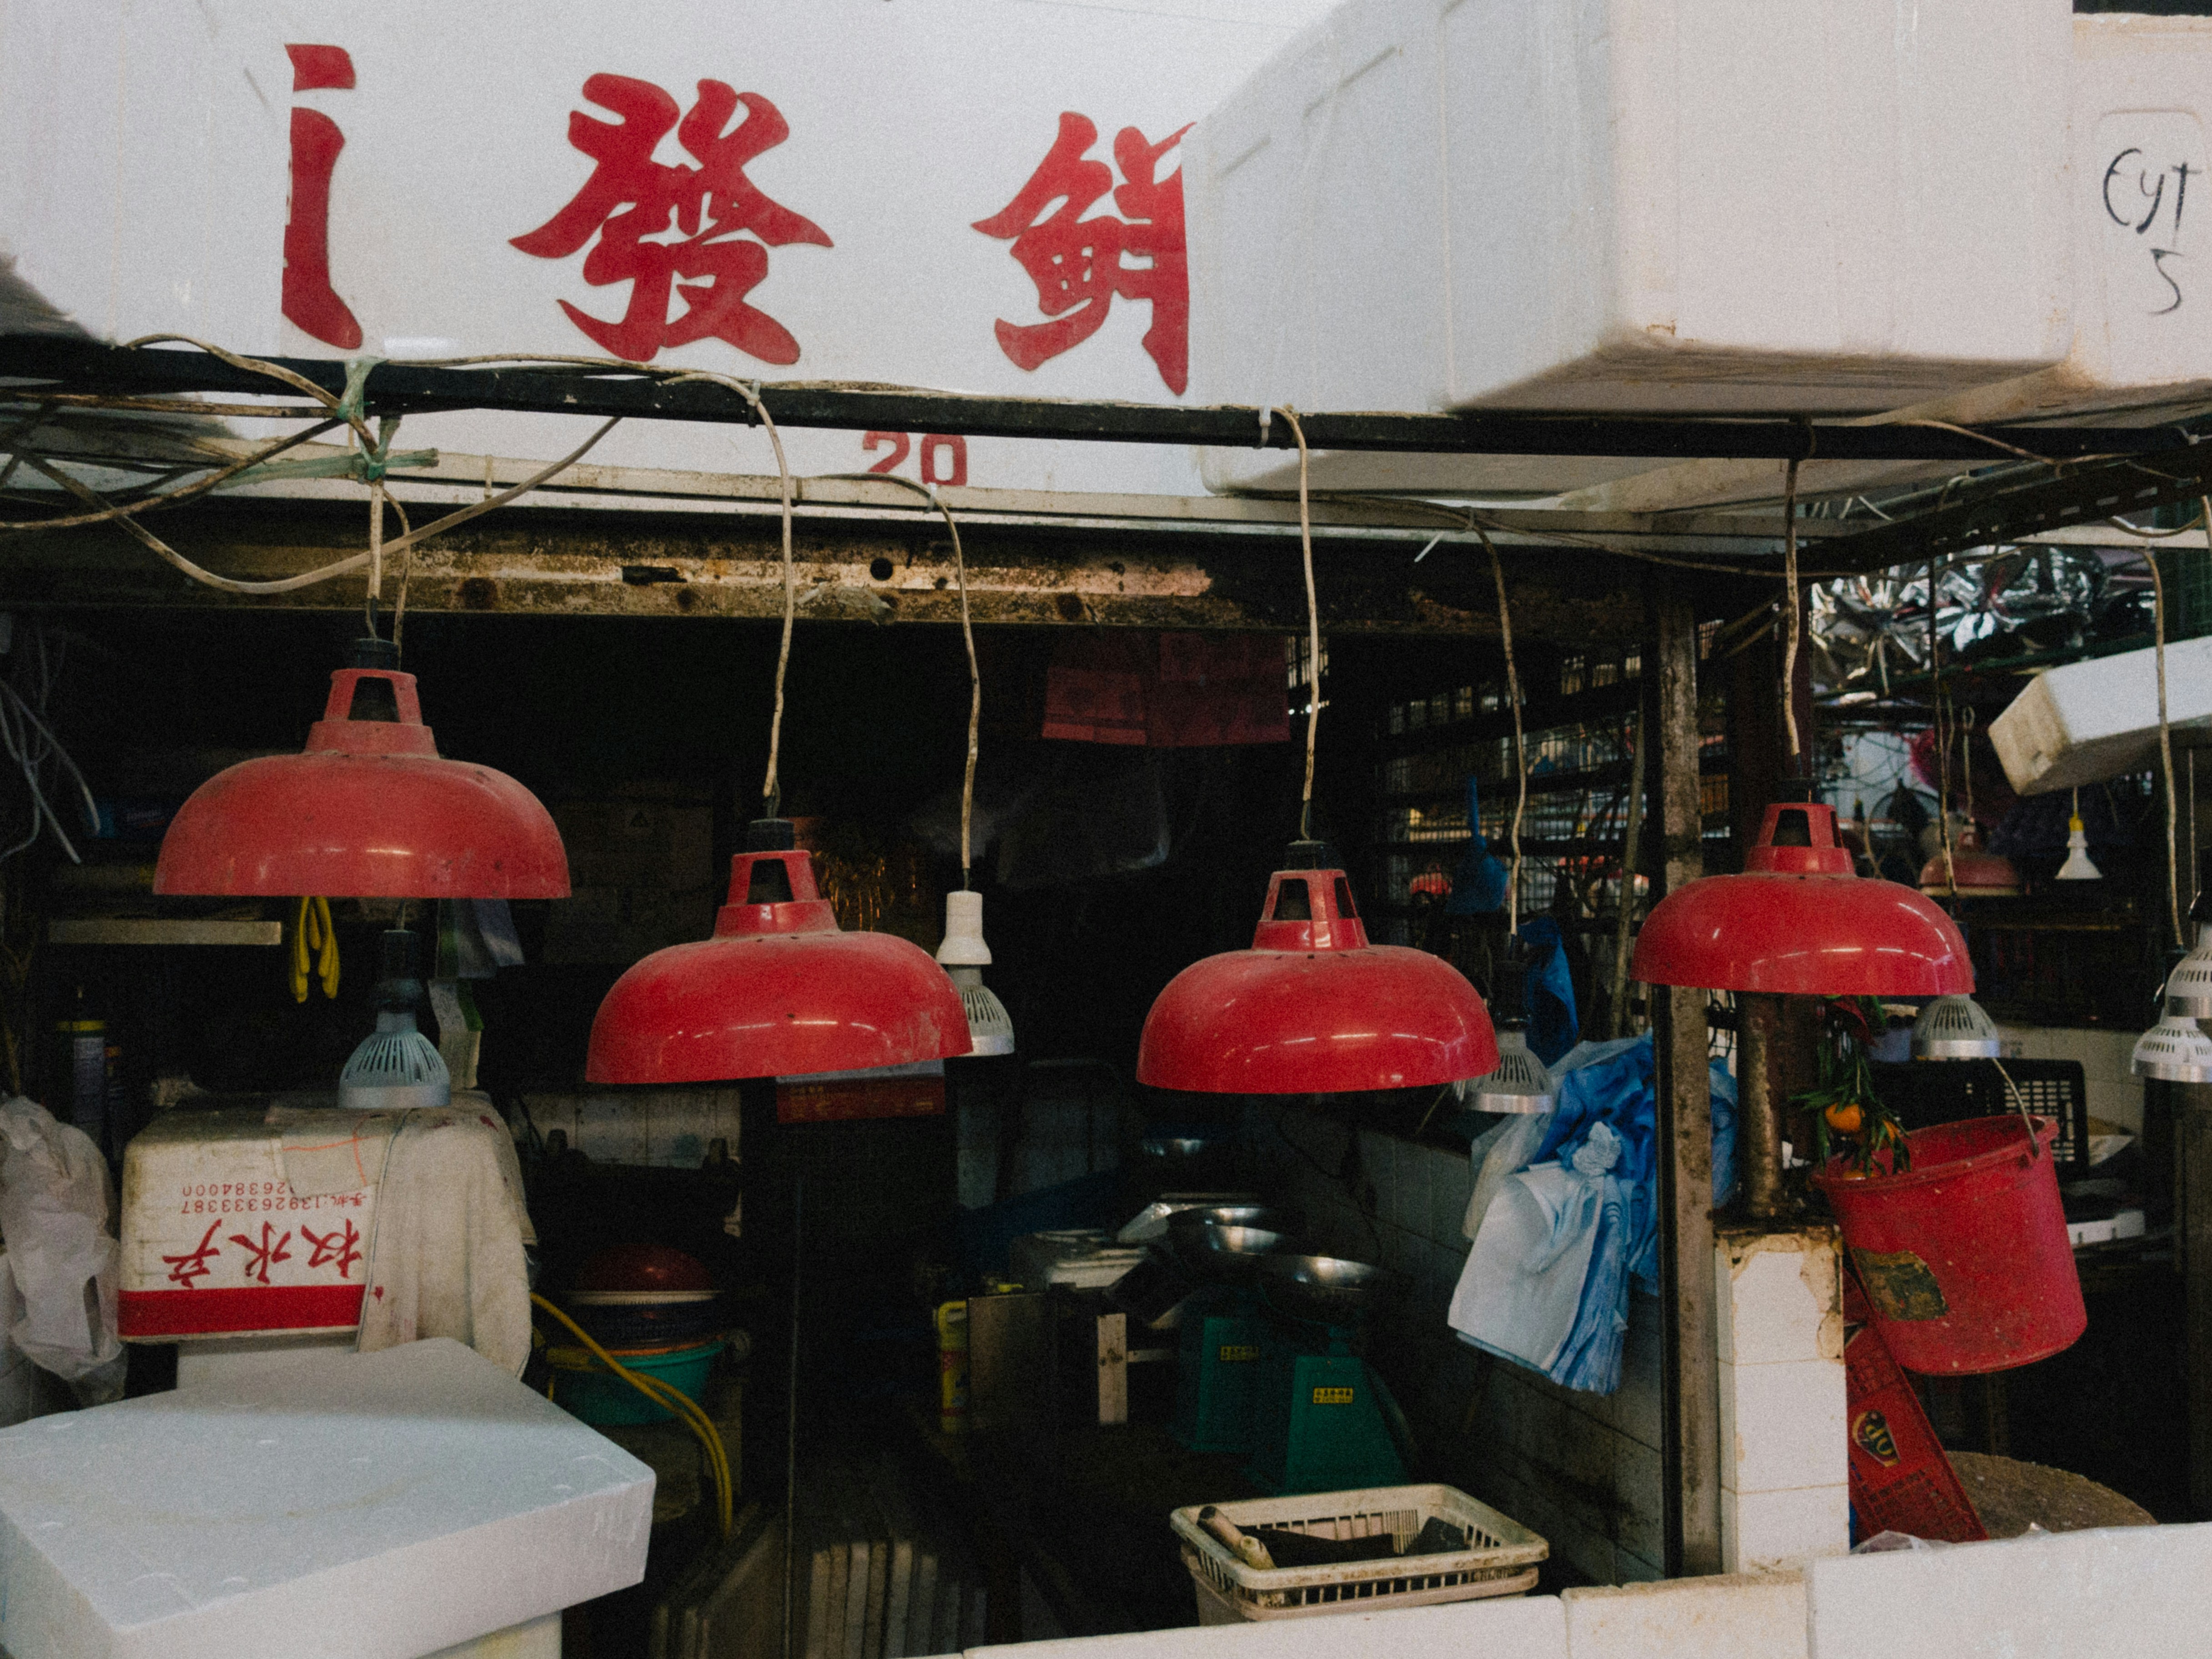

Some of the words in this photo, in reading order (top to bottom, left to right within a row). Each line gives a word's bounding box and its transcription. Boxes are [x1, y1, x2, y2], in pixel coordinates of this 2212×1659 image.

[863, 430, 967, 486] 20
[162, 1218, 362, 1289] 权水产
